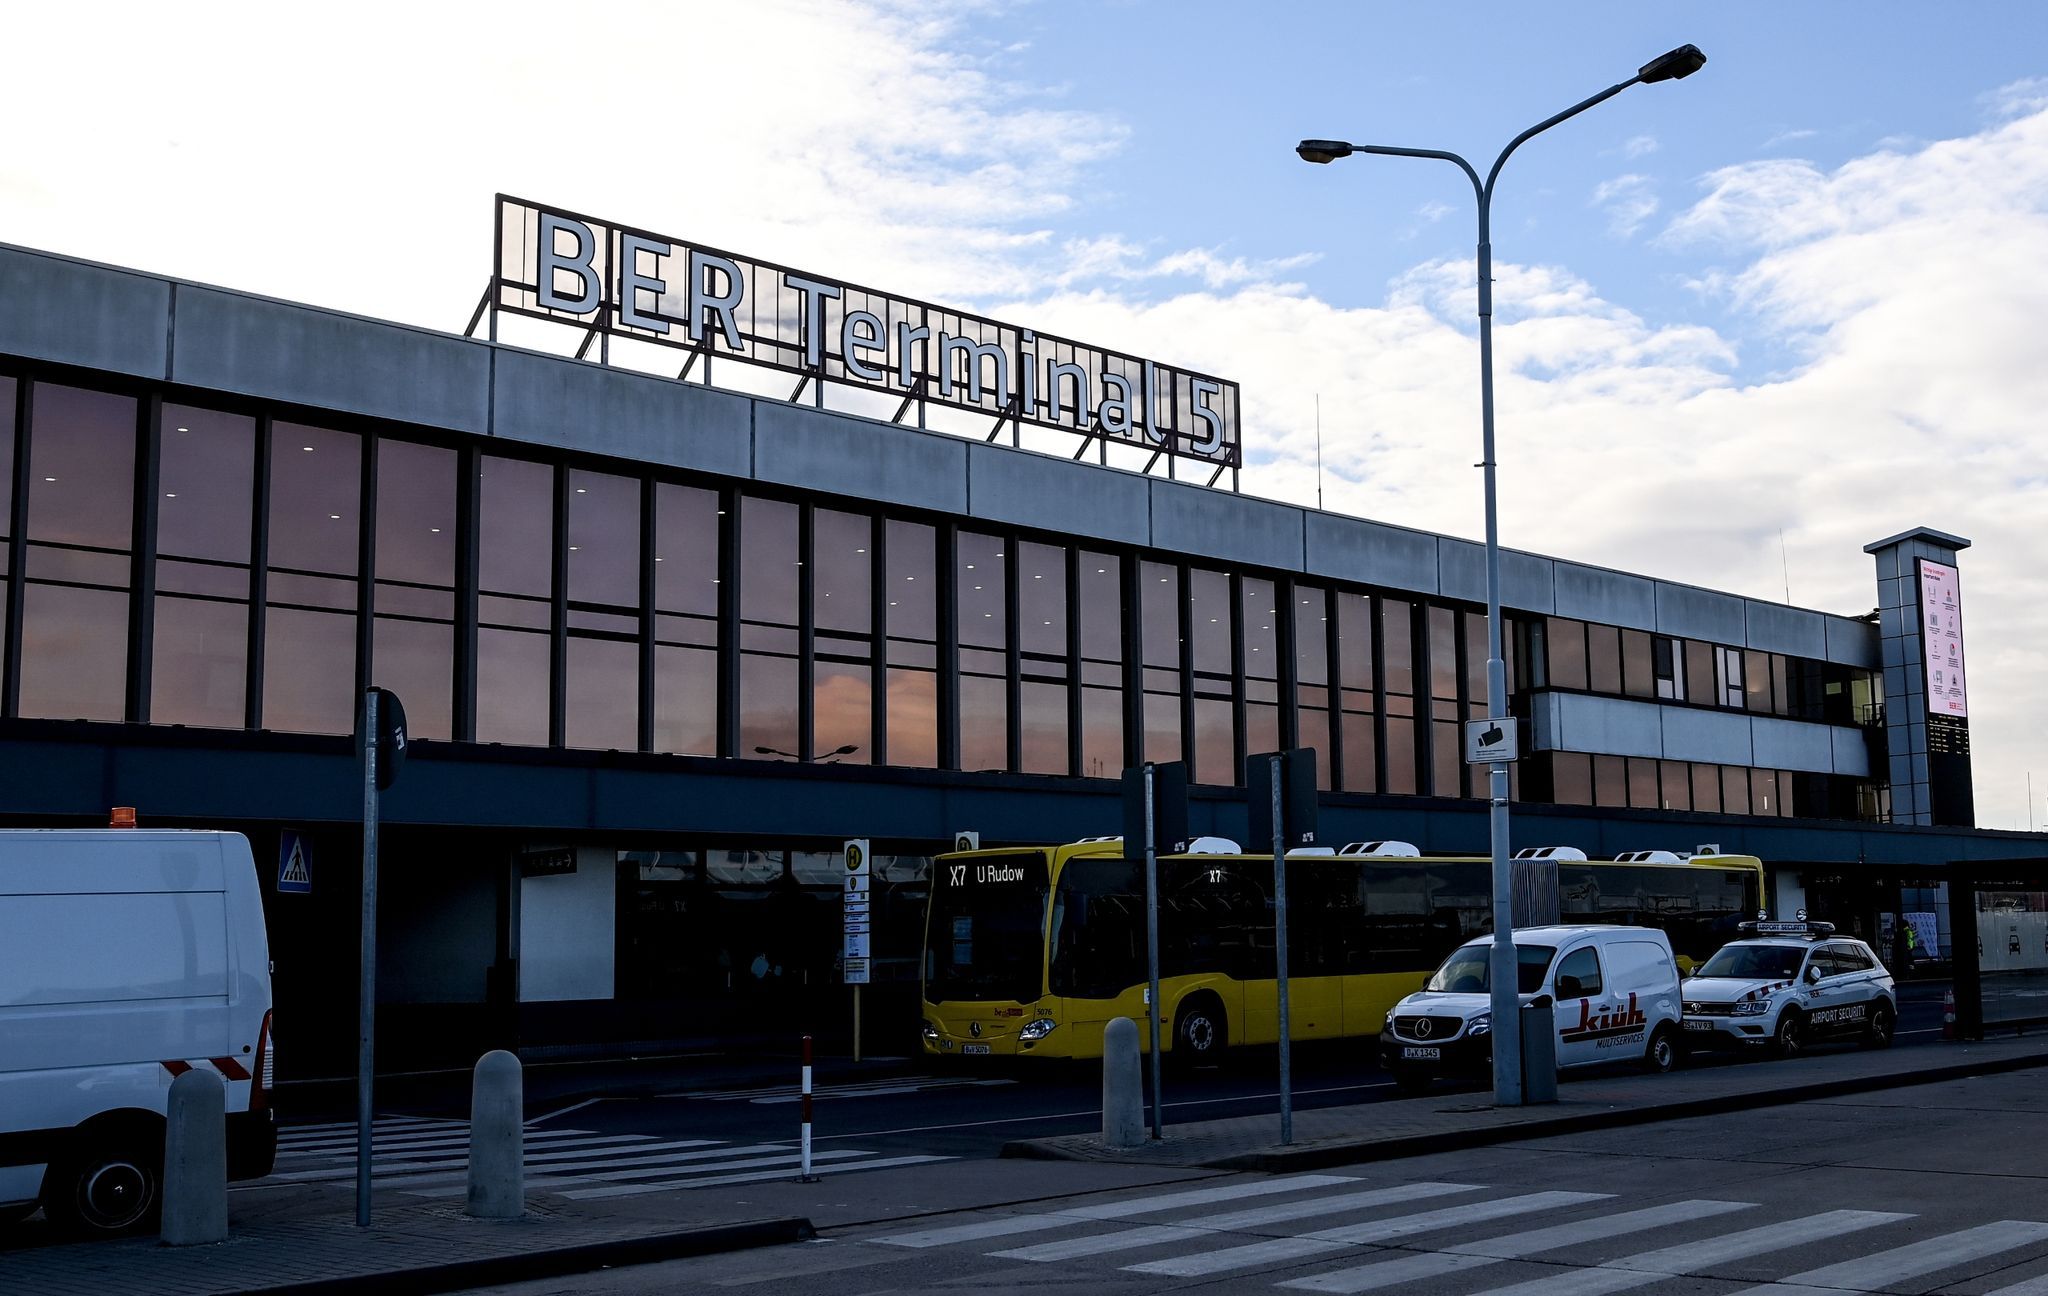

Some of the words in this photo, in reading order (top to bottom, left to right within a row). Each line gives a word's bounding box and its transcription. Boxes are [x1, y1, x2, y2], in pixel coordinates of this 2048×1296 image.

[536, 211, 745, 352] BER
[784, 272, 1166, 446] Terminal
[1190, 377, 1223, 455] 5
[949, 865, 967, 887] X7
[977, 865, 986, 883] U
[988, 864, 1024, 882] Rudow
[1209, 869, 1221, 884] X7
[1758, 923, 1779, 931] AIRPORT
[1780, 923, 1806, 931] SECURITY
[1037, 1008, 1053, 1016] 5076
[1811, 1009, 1838, 1025] AIRPORT
[1838, 1004, 1866, 1020] SECURITY
[1595, 1033, 1645, 1048] MULTISERVICES
[1420, 1048, 1438, 1057] 1345
